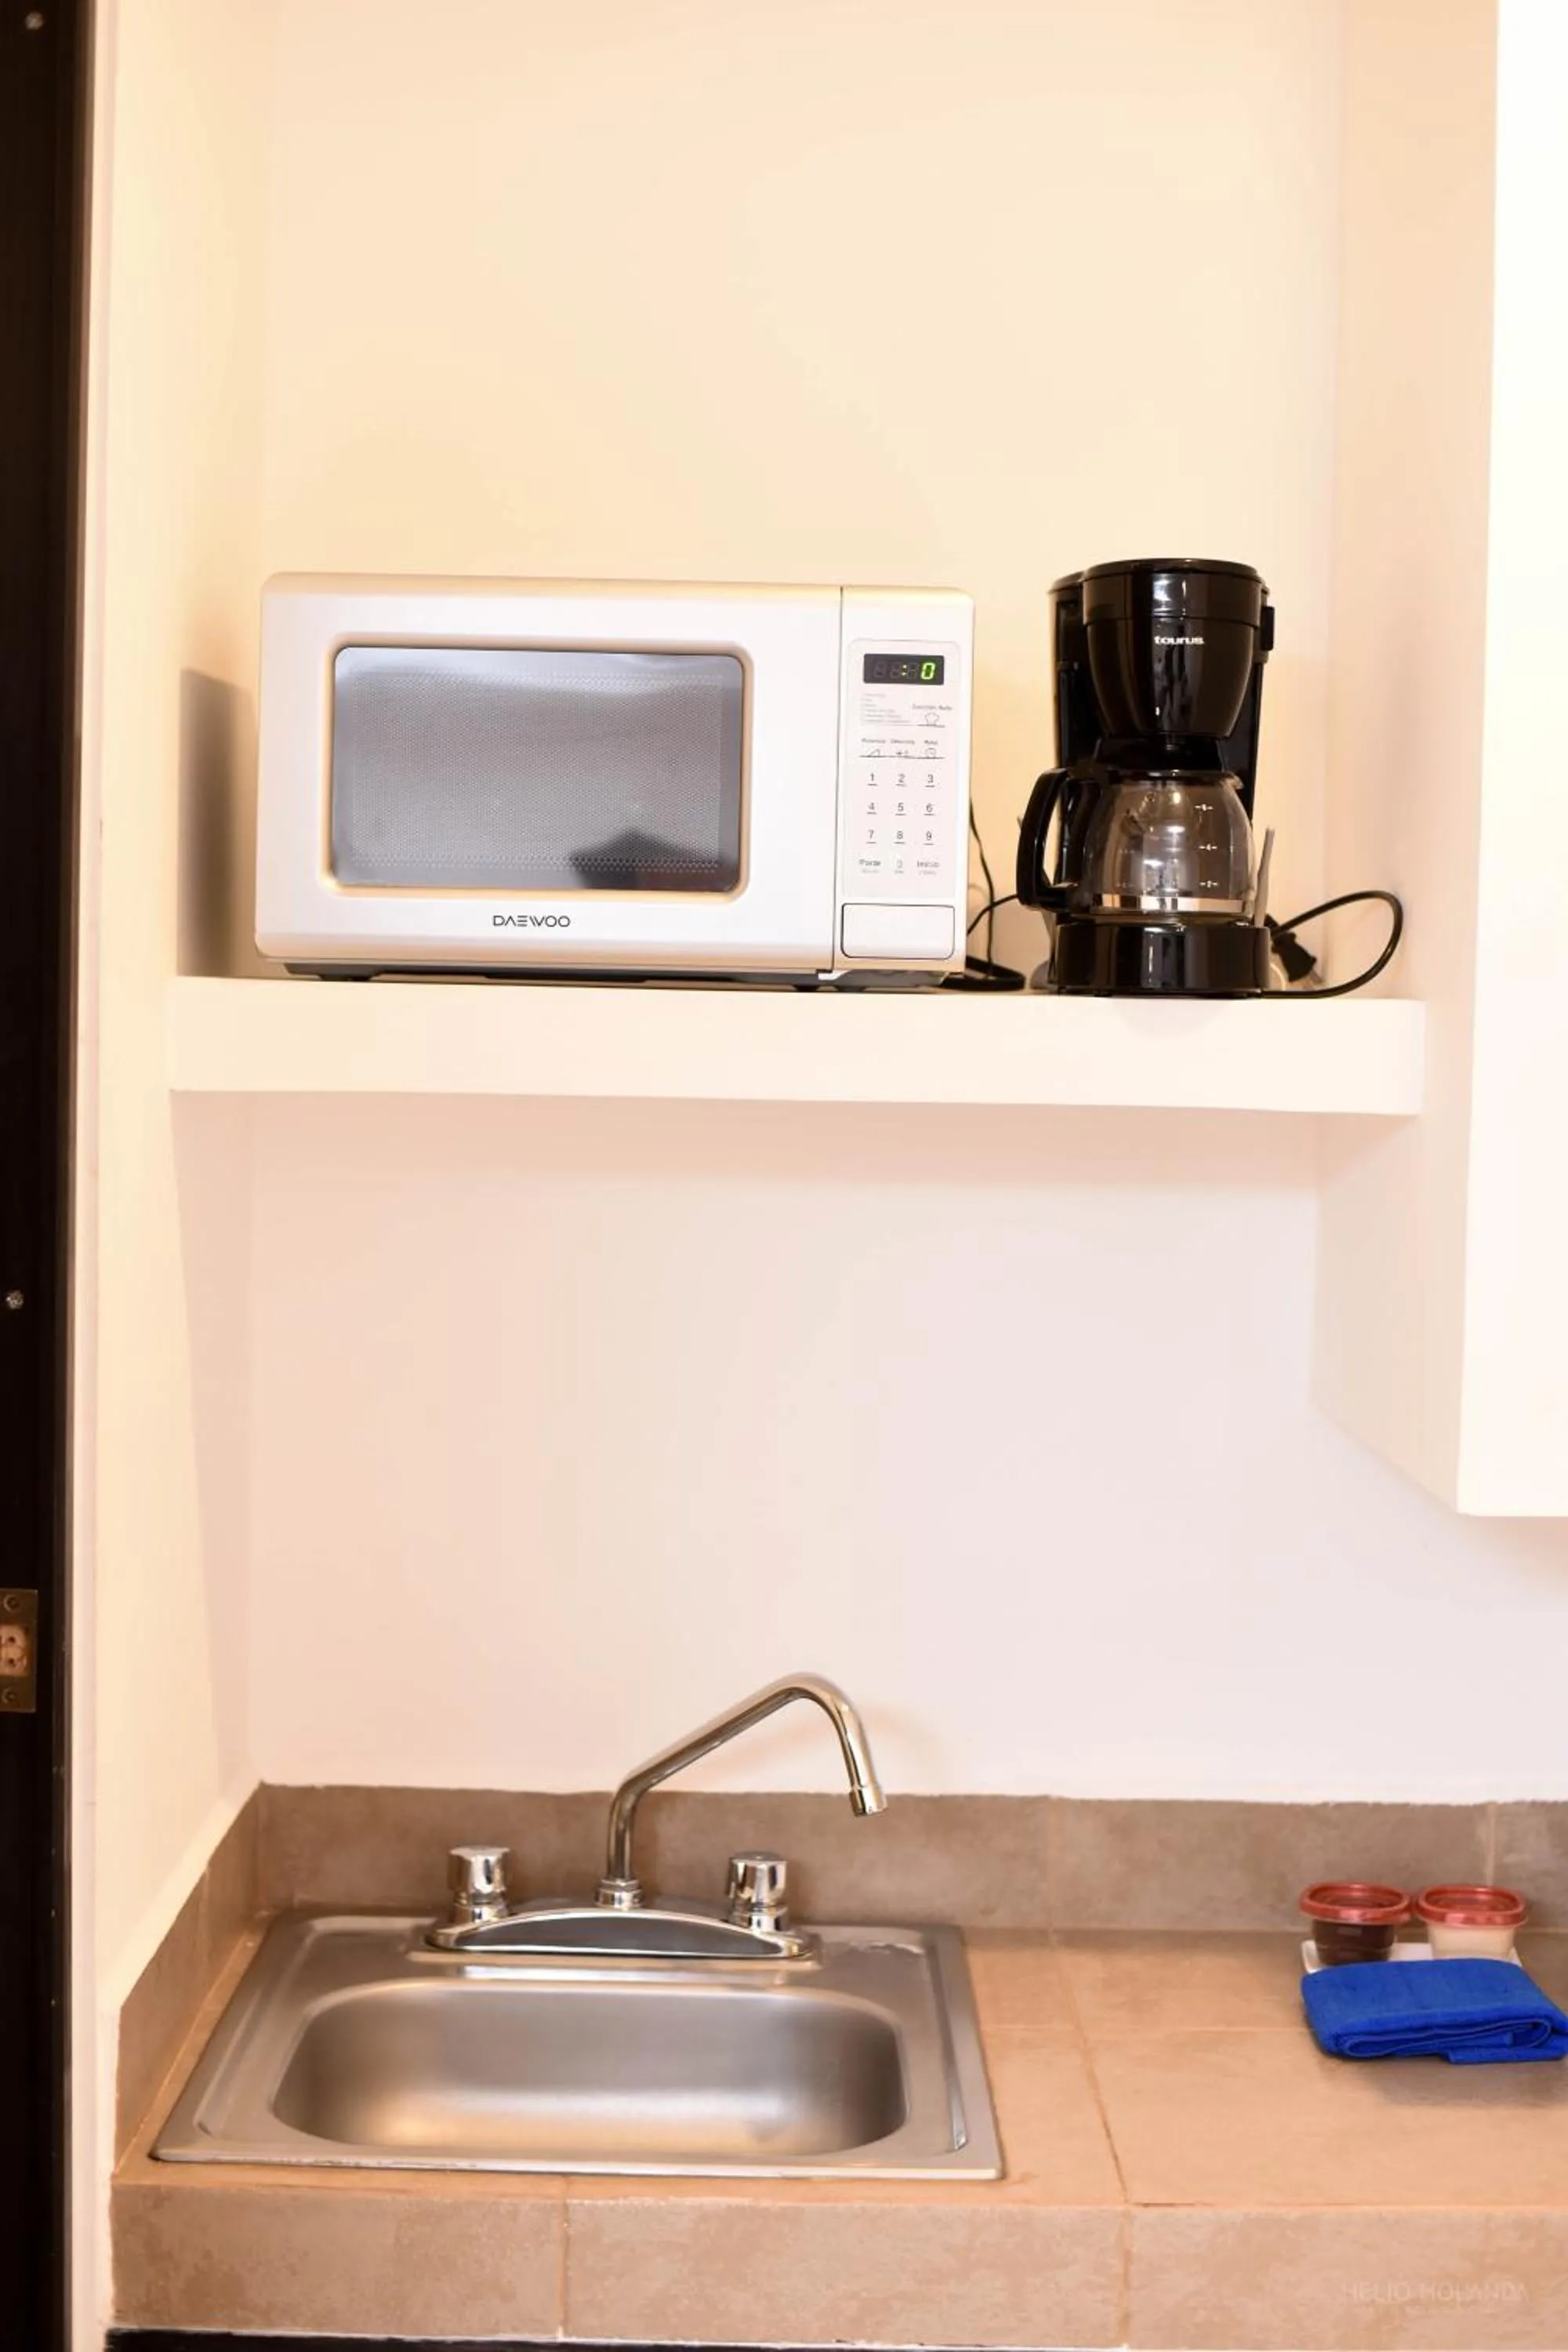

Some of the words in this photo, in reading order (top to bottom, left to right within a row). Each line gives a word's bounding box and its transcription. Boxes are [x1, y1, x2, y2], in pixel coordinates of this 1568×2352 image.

[1154, 636, 1204, 644] taurus
[869, 772, 875, 782] 1
[898, 773, 906, 783] 2
[927, 774, 934, 783] 3
[868, 802, 875, 811] 4
[898, 802, 904, 811] 5
[926, 803, 933, 812] 6
[868, 829, 874, 839] 7
[896, 830, 903, 840] 8
[926, 831, 932, 840] 9
[492, 915, 572, 927] DAEWOO
